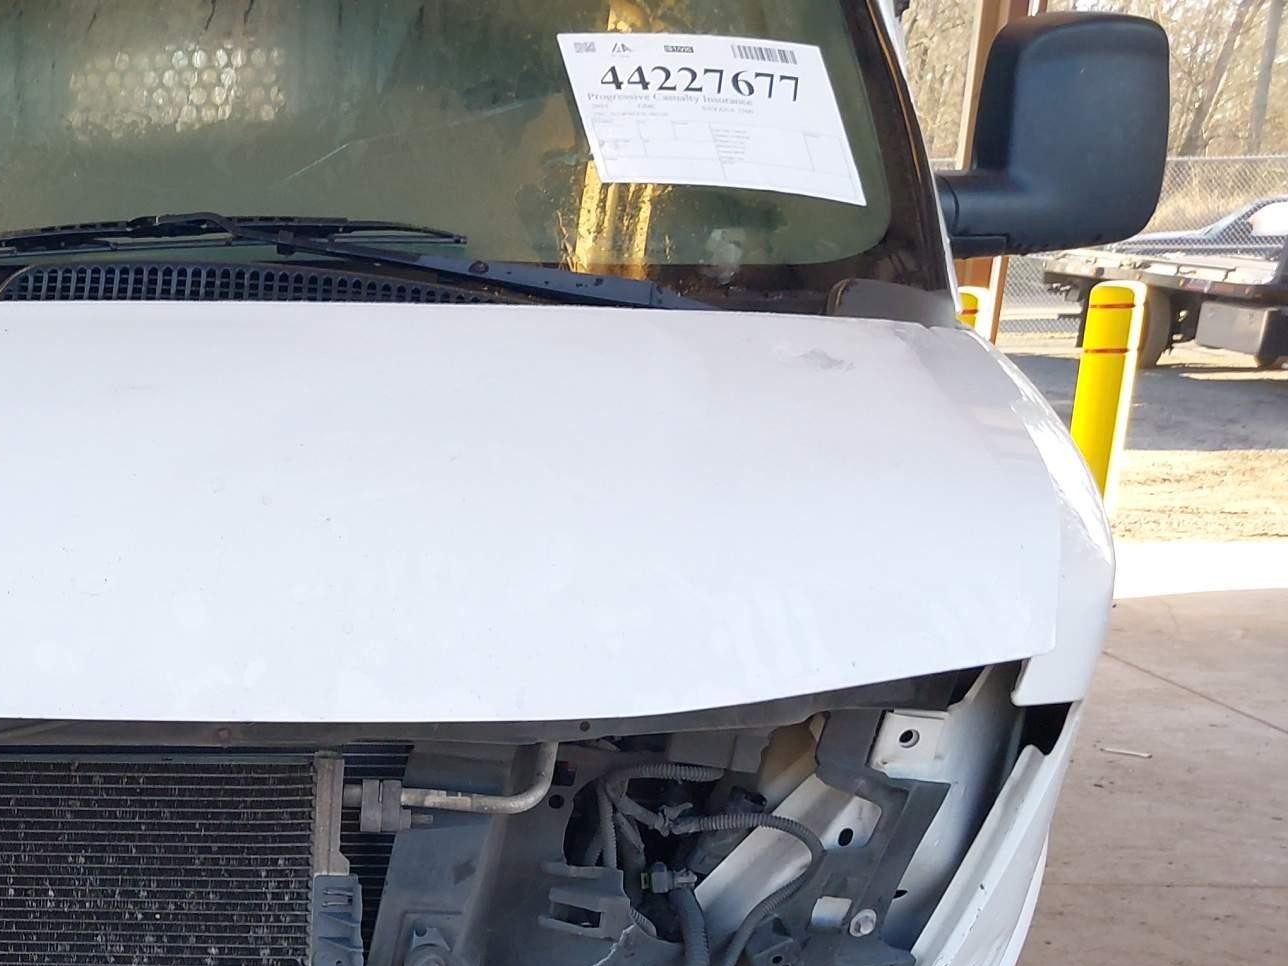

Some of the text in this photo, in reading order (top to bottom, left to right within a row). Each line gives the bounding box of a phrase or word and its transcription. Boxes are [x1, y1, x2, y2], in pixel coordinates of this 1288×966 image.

[600, 65, 799, 102] 44227677
[587, 92, 650, 102] Progressive
[703, 95, 753, 106] Insurance
